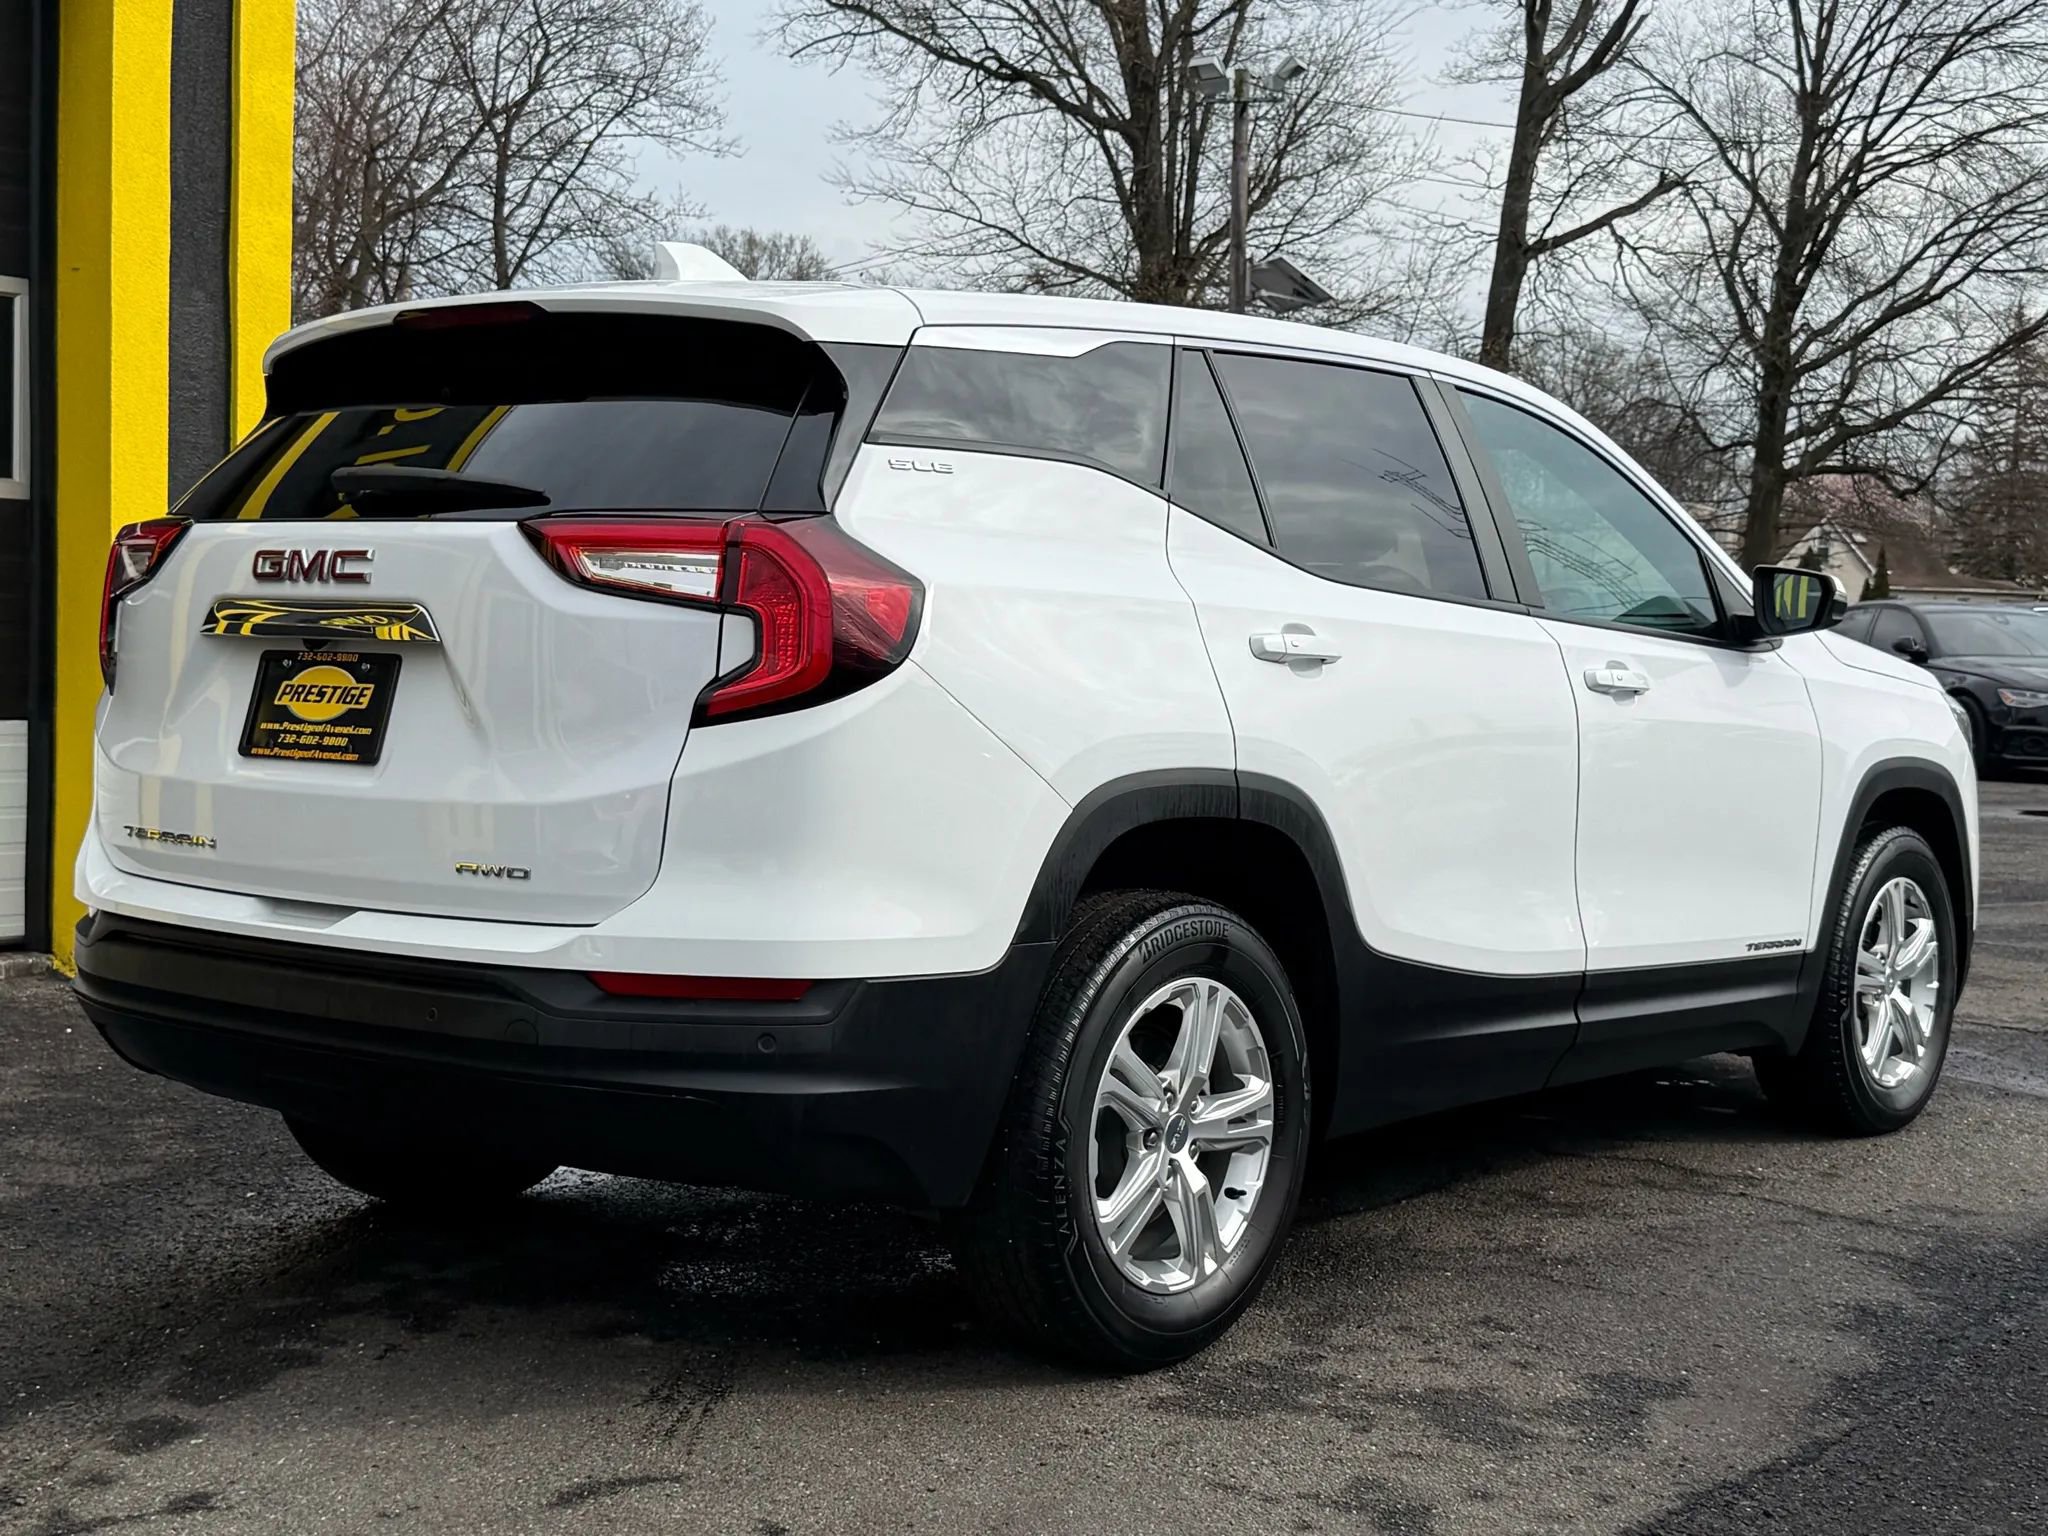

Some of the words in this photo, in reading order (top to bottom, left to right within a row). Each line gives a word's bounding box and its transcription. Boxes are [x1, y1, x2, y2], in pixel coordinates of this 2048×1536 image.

[251, 547, 375, 584] GMC
[277, 683, 371, 706] PRESTIGE
[277, 733, 349, 747] 732-602-9800
[123, 825, 217, 849] TERRAIN
[455, 860, 532, 880] AWD
[1138, 919, 1230, 965] BRIDGESTONE
[1054, 1138, 1071, 1235] ALENZA
